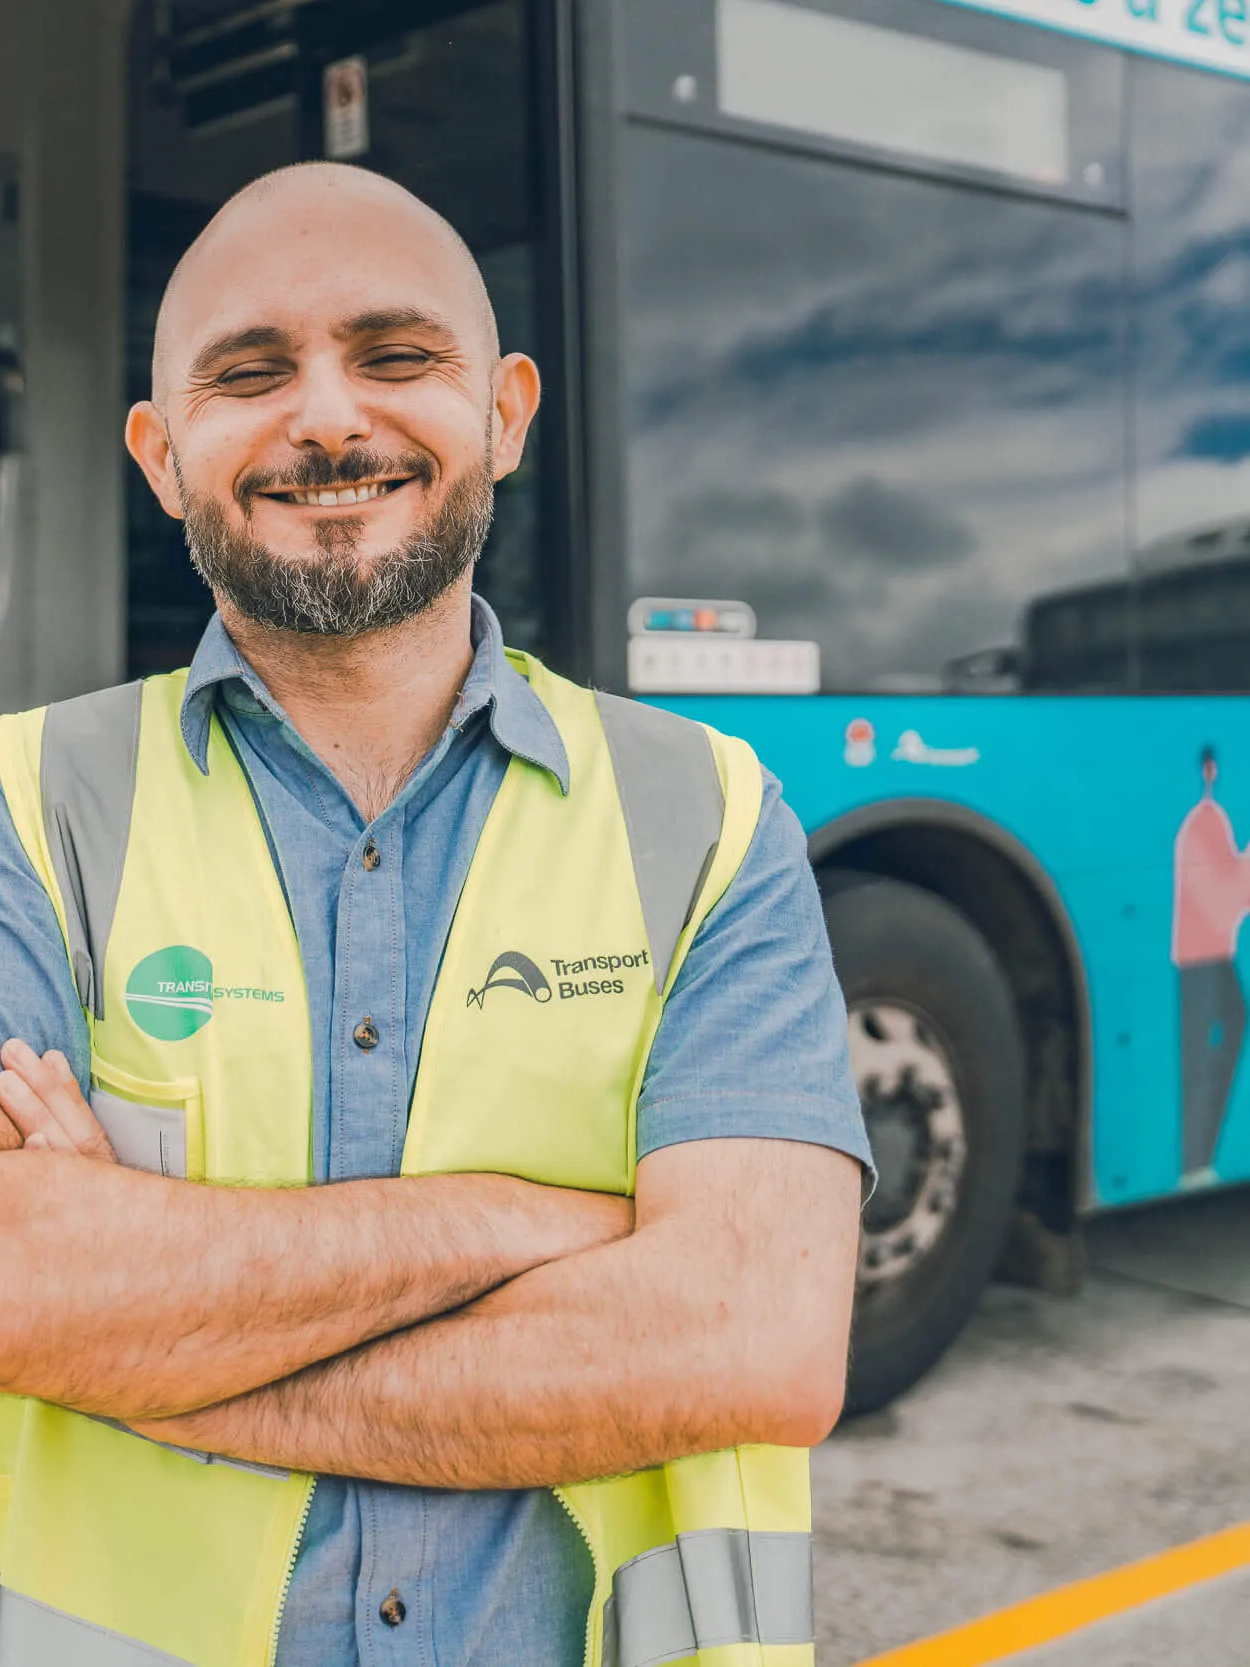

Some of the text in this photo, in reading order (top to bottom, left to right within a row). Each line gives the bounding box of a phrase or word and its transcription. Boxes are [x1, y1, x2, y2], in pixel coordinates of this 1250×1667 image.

[551, 949, 649, 977] Transport
[213, 986, 285, 1002] SYSTEMS
[558, 979, 624, 1000] Buses
